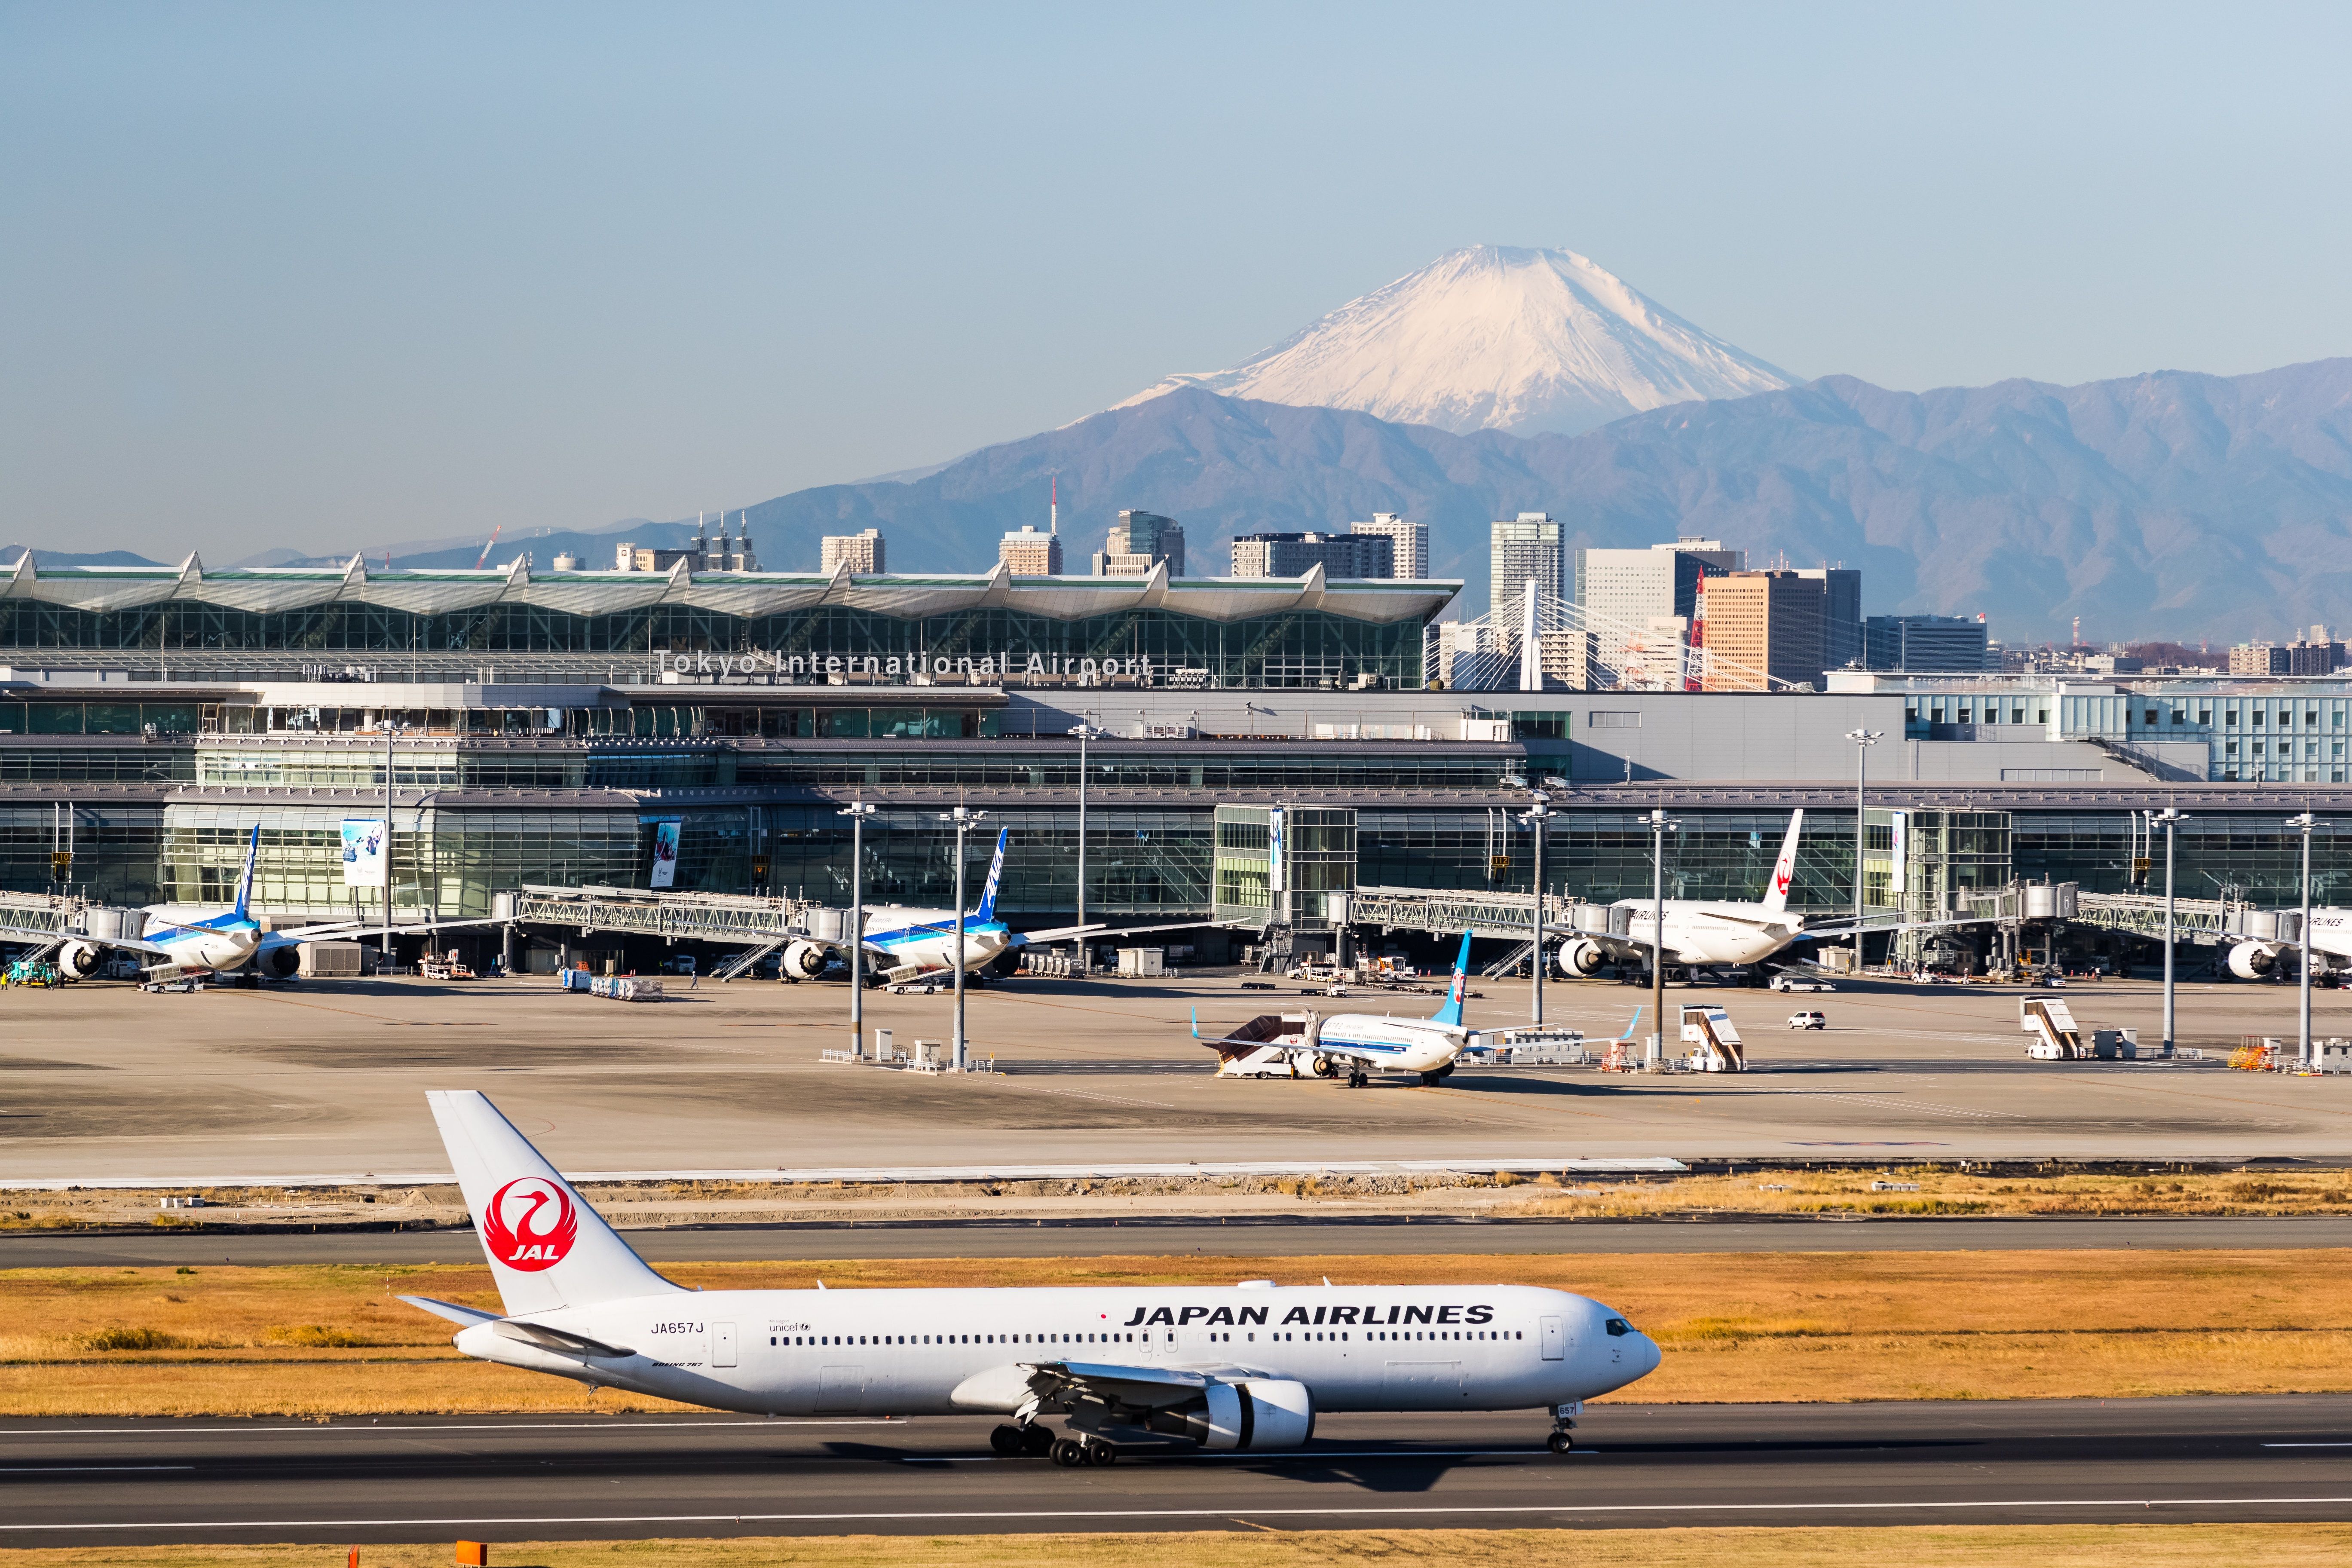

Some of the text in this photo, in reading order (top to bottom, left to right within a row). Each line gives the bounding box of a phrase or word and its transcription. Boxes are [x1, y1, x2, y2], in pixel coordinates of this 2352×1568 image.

[653, 650, 1150, 682] Tokyo International Airport
[1631, 910, 1669, 921] AIRLINS
[2309, 917, 2343, 926] IRLINES
[508, 1245, 559, 1260] JAL
[1124, 1305, 1494, 1326] JAPAN AIRLINES
[651, 1323, 703, 1334] JA657J
[769, 1323, 798, 1332] unicef
